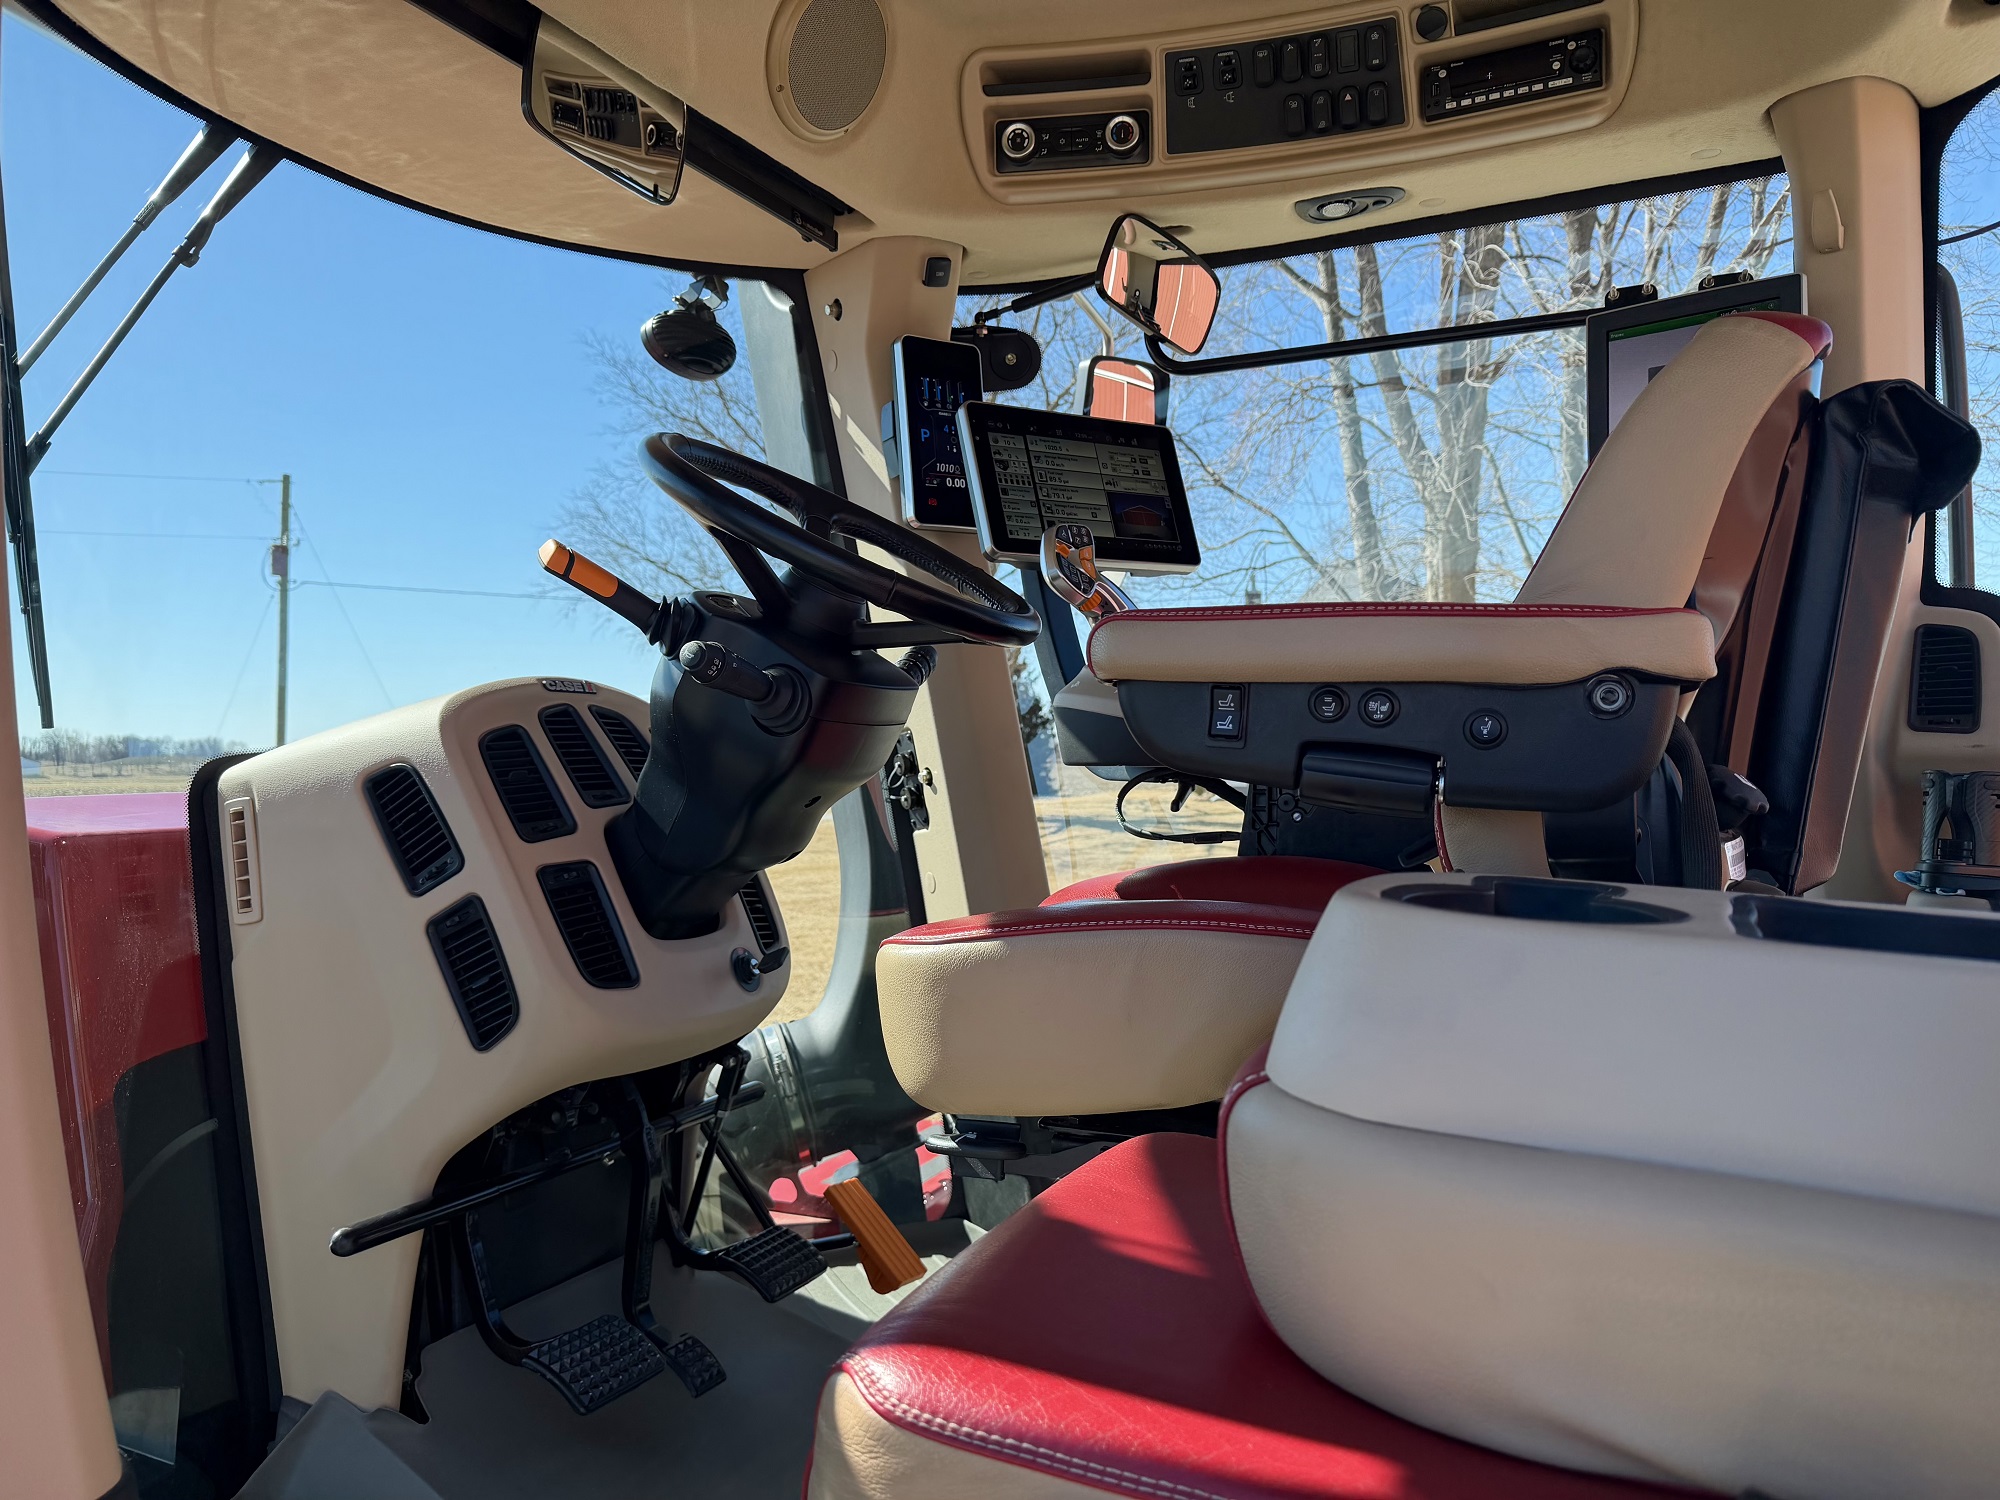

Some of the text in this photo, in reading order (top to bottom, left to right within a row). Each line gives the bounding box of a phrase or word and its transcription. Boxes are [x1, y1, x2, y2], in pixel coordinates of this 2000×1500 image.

[920, 428, 930, 442] P
[936, 463, 955, 473] 1010
[946, 477, 966, 488] 0.00
[545, 679, 584, 692] CASE
